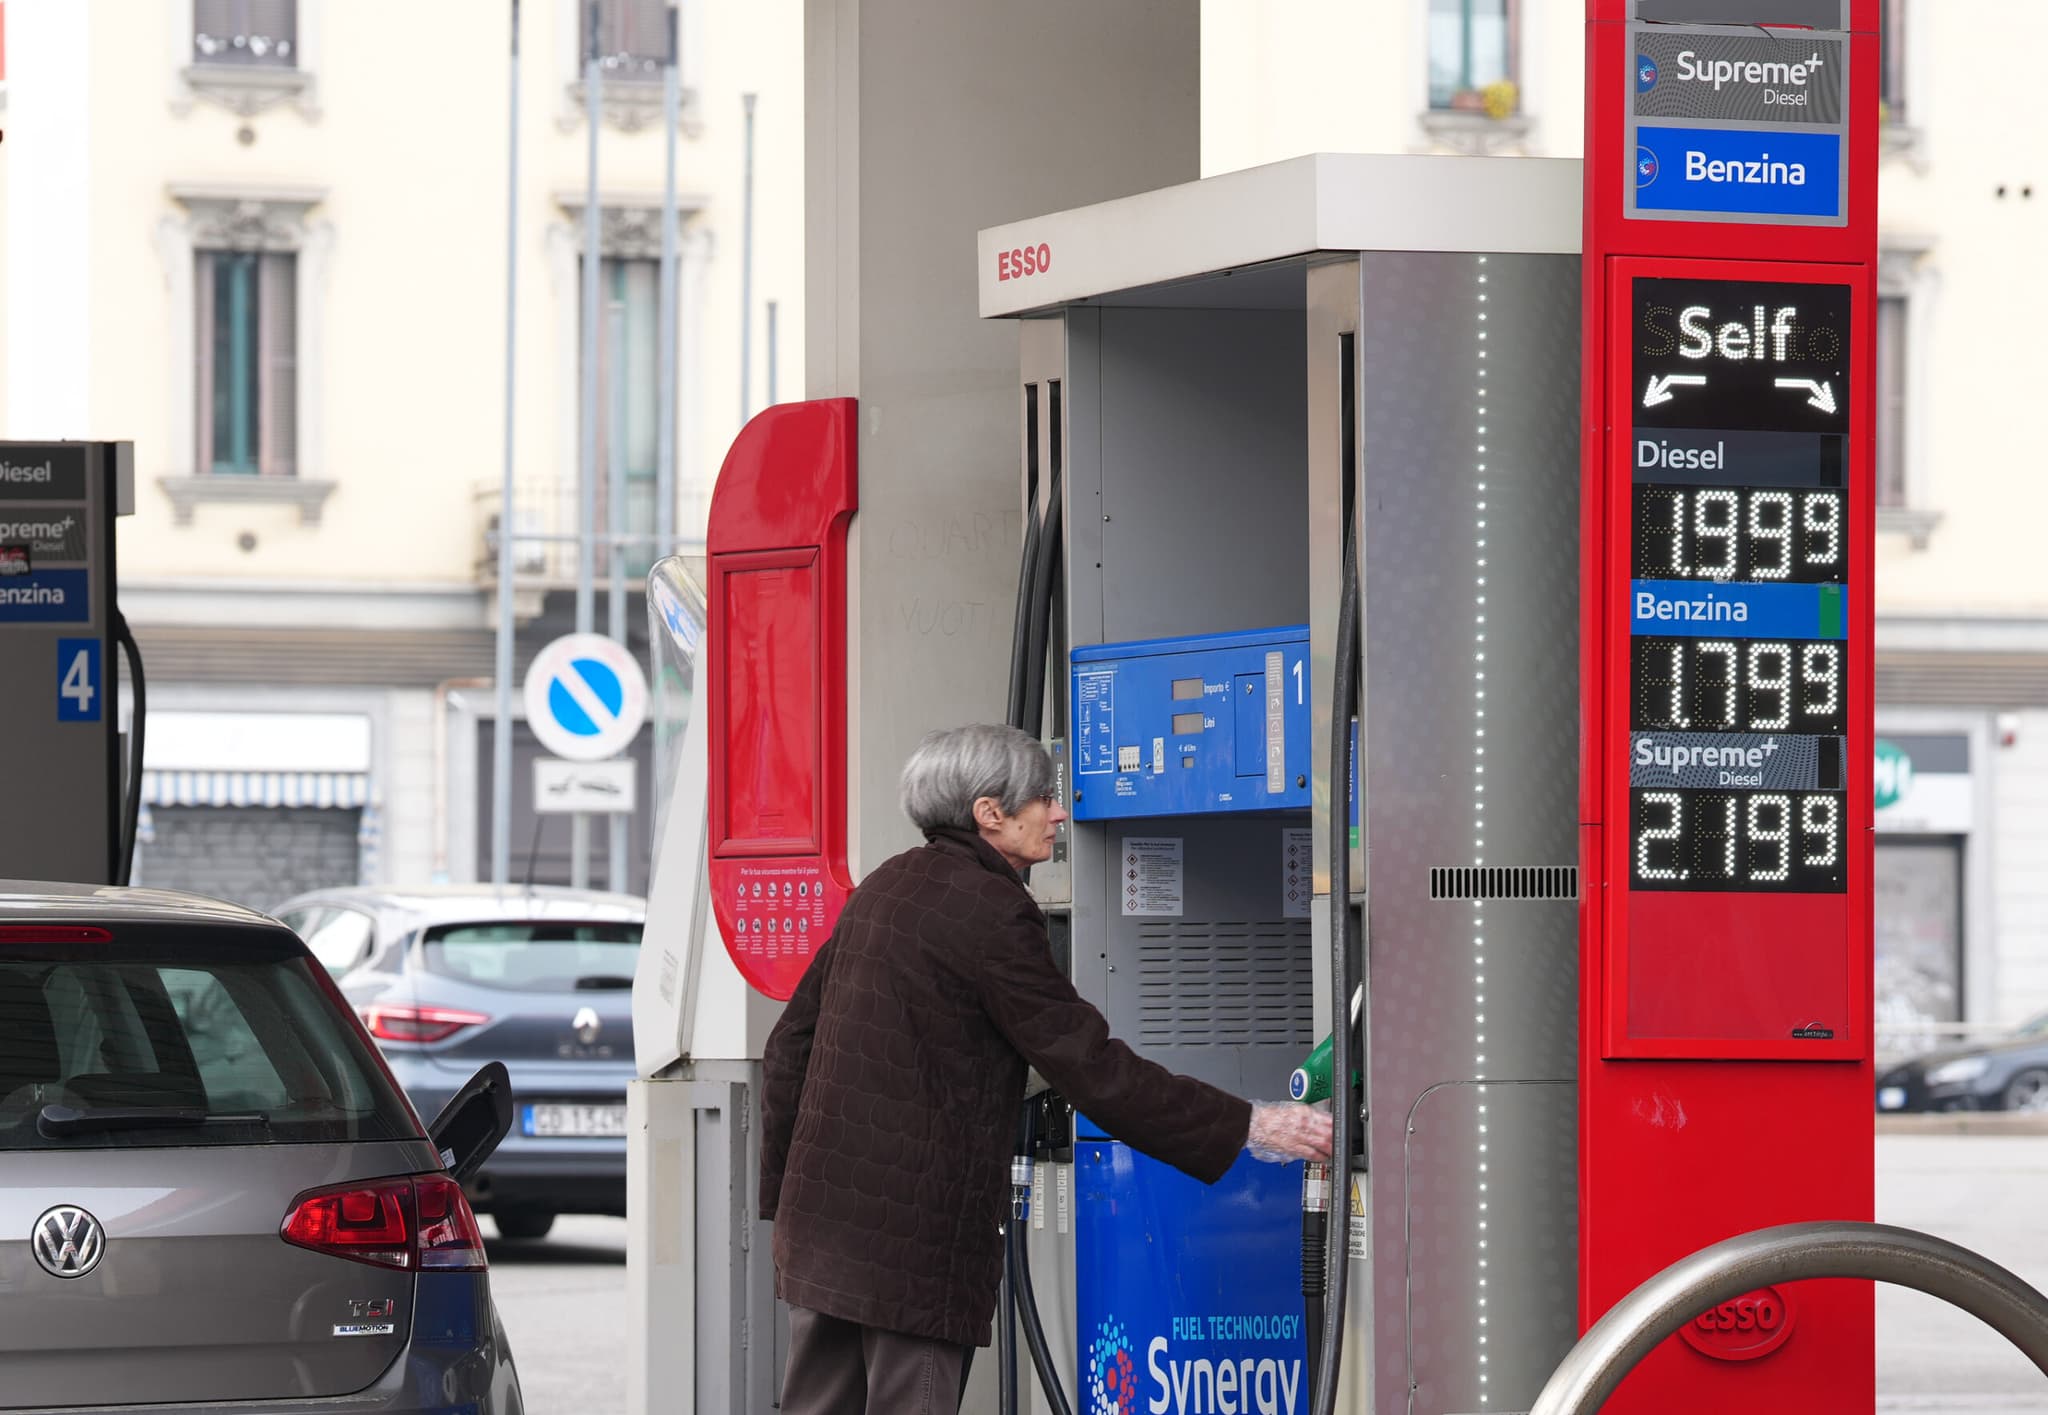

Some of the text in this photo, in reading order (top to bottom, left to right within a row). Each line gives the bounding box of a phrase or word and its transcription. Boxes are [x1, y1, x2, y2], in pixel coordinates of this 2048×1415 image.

[1676, 50, 1823, 90] Supreme+
[1763, 89, 1808, 107] Diesel
[1685, 151, 1805, 185] Benzina
[998, 243, 1051, 282] ESSO
[1678, 305, 1796, 361] Self
[1637, 440, 1724, 470] Diesel
[1671, 490, 1839, 578] 1.999
[1636, 592, 1748, 623] Benzina
[61, 649, 94, 712] 4
[1292, 660, 1303, 705] 1
[1671, 641, 1838, 729] 1.799
[1635, 736, 1778, 773] Supreme+
[1719, 770, 1763, 787] Diesel
[1637, 792, 1838, 881] 2.199
[348, 1299, 393, 1317] TSI
[1172, 1315, 1299, 1340] FUEL TECHNOLOGY
[1148, 1336, 1301, 1415] Synergy
